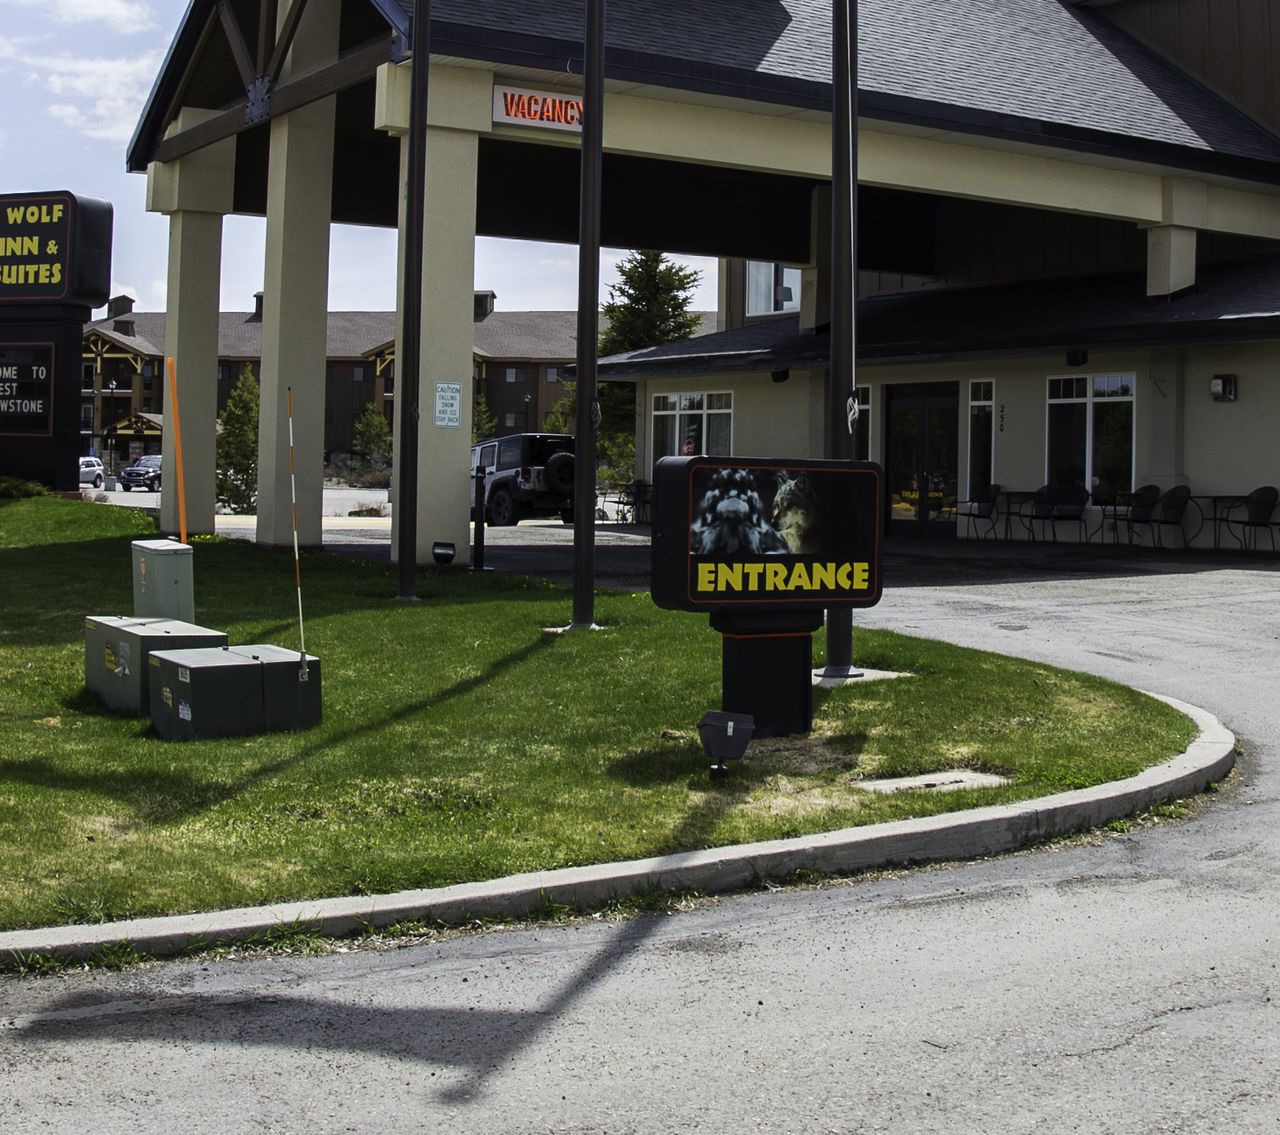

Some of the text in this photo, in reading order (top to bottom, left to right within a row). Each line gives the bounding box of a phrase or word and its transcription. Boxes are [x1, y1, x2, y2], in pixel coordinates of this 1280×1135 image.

[6, 204, 64, 224] WOLF
[0, 236, 59, 256] INN &
[31, 366, 46, 379] TO
[697, 562, 869, 592] ENTRANCE
